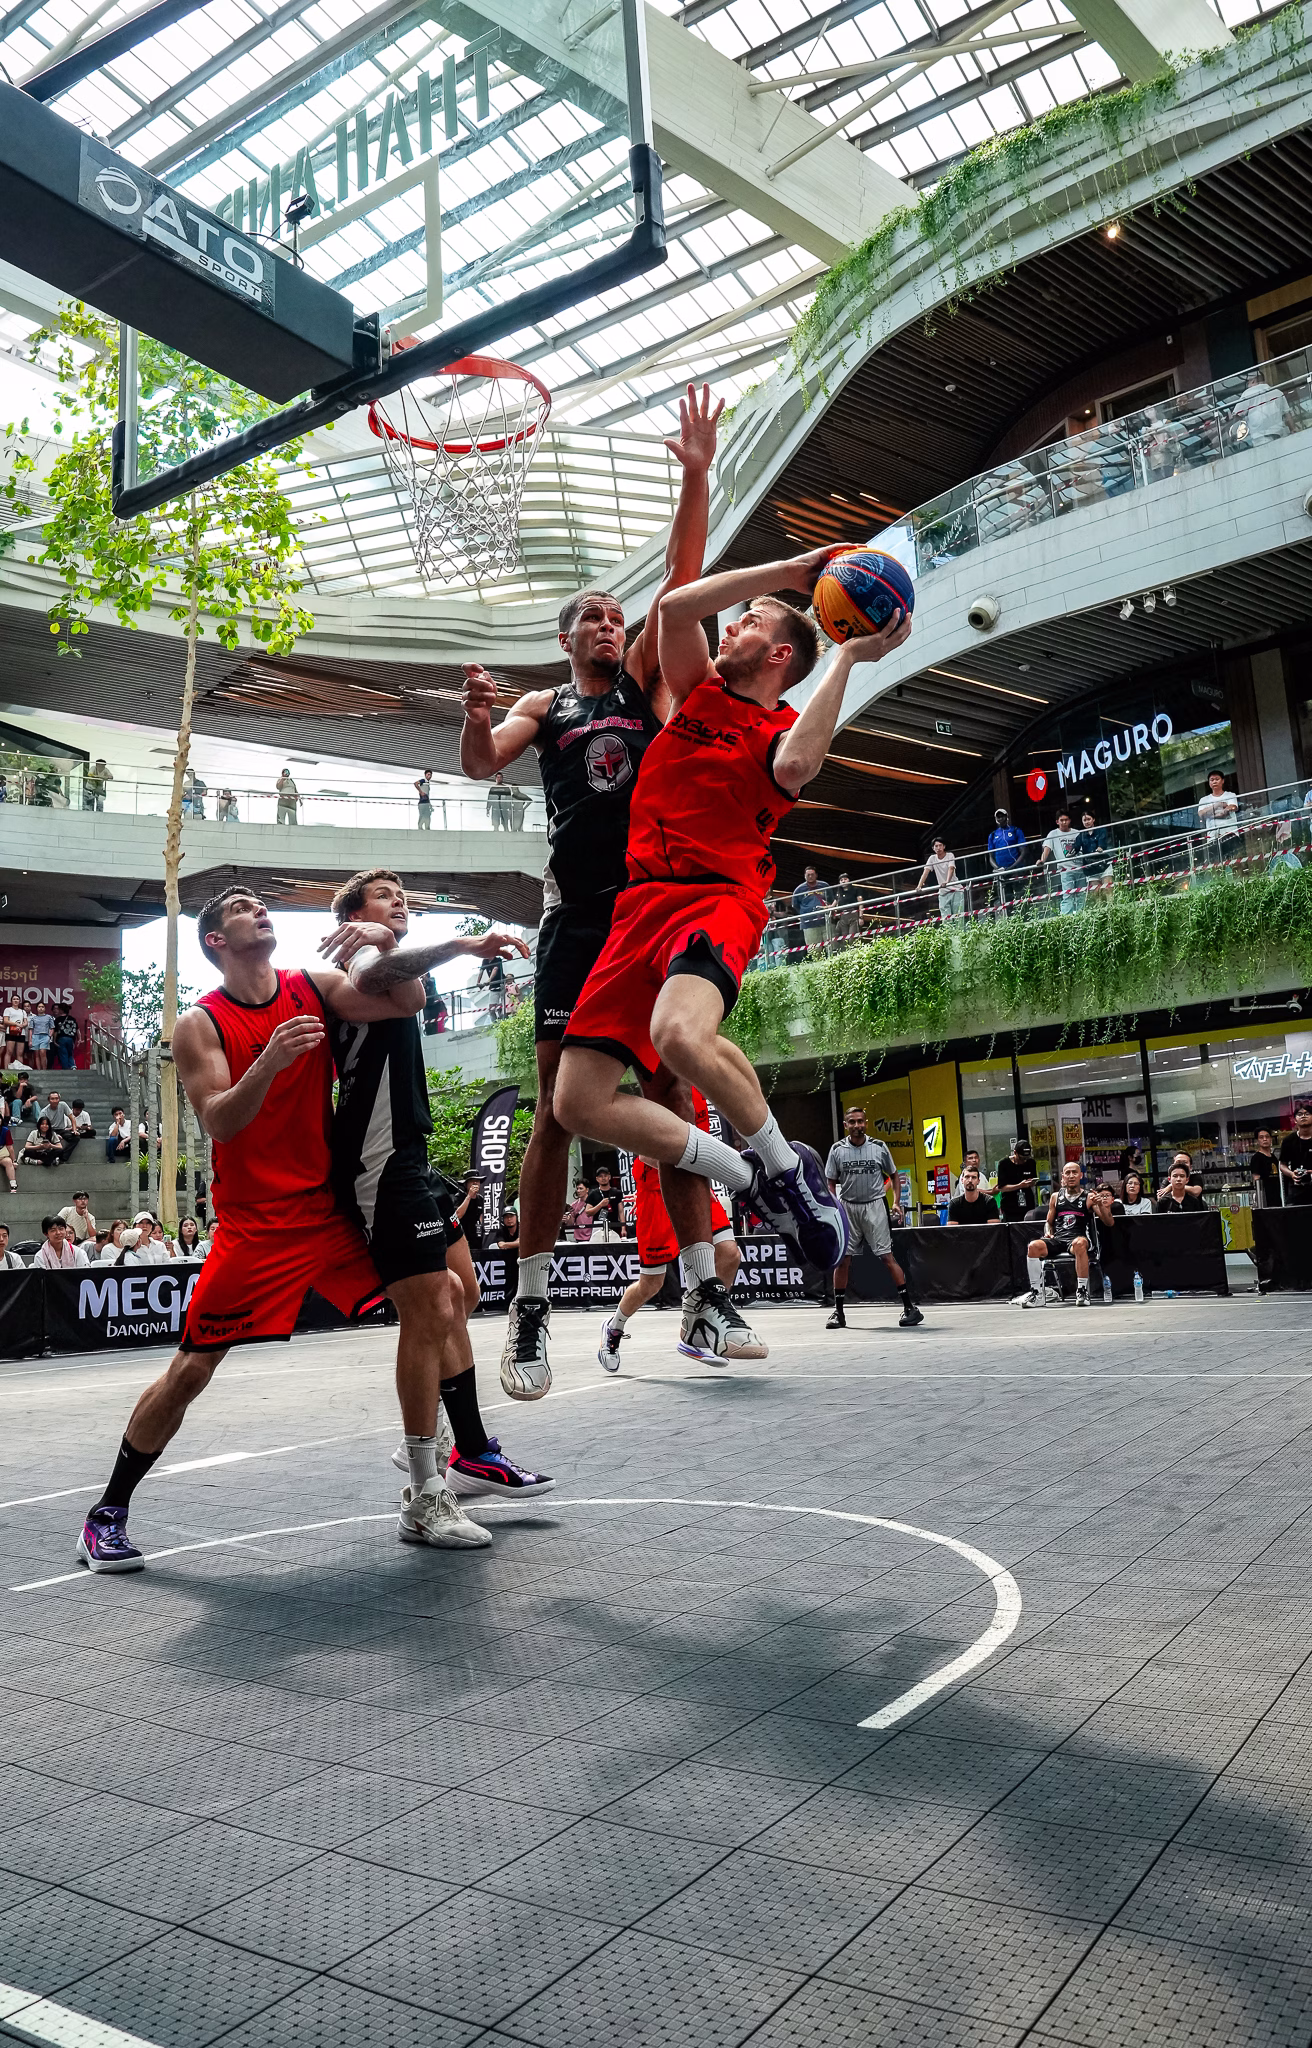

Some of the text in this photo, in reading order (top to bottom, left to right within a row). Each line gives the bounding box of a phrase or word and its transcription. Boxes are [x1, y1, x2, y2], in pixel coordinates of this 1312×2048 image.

[198, 255, 261, 297] SPORT
[1198, 685, 1224, 700] MAGURO
[1056, 713, 1173, 789] MAGURO
[544, 1008, 570, 1017] Victo
[1233, 1051, 1312, 1082] マツモトキ
[481, 1115, 510, 1174] SHOP
[738, 1244, 788, 1262] ARPE
[734, 1267, 804, 1286] ASTER
[480, 1291, 505, 1302] MIER
[547, 1286, 627, 1298] UPER PREMI
[730, 1291, 750, 1300] rpet
[756, 1291, 780, 1299] Since
